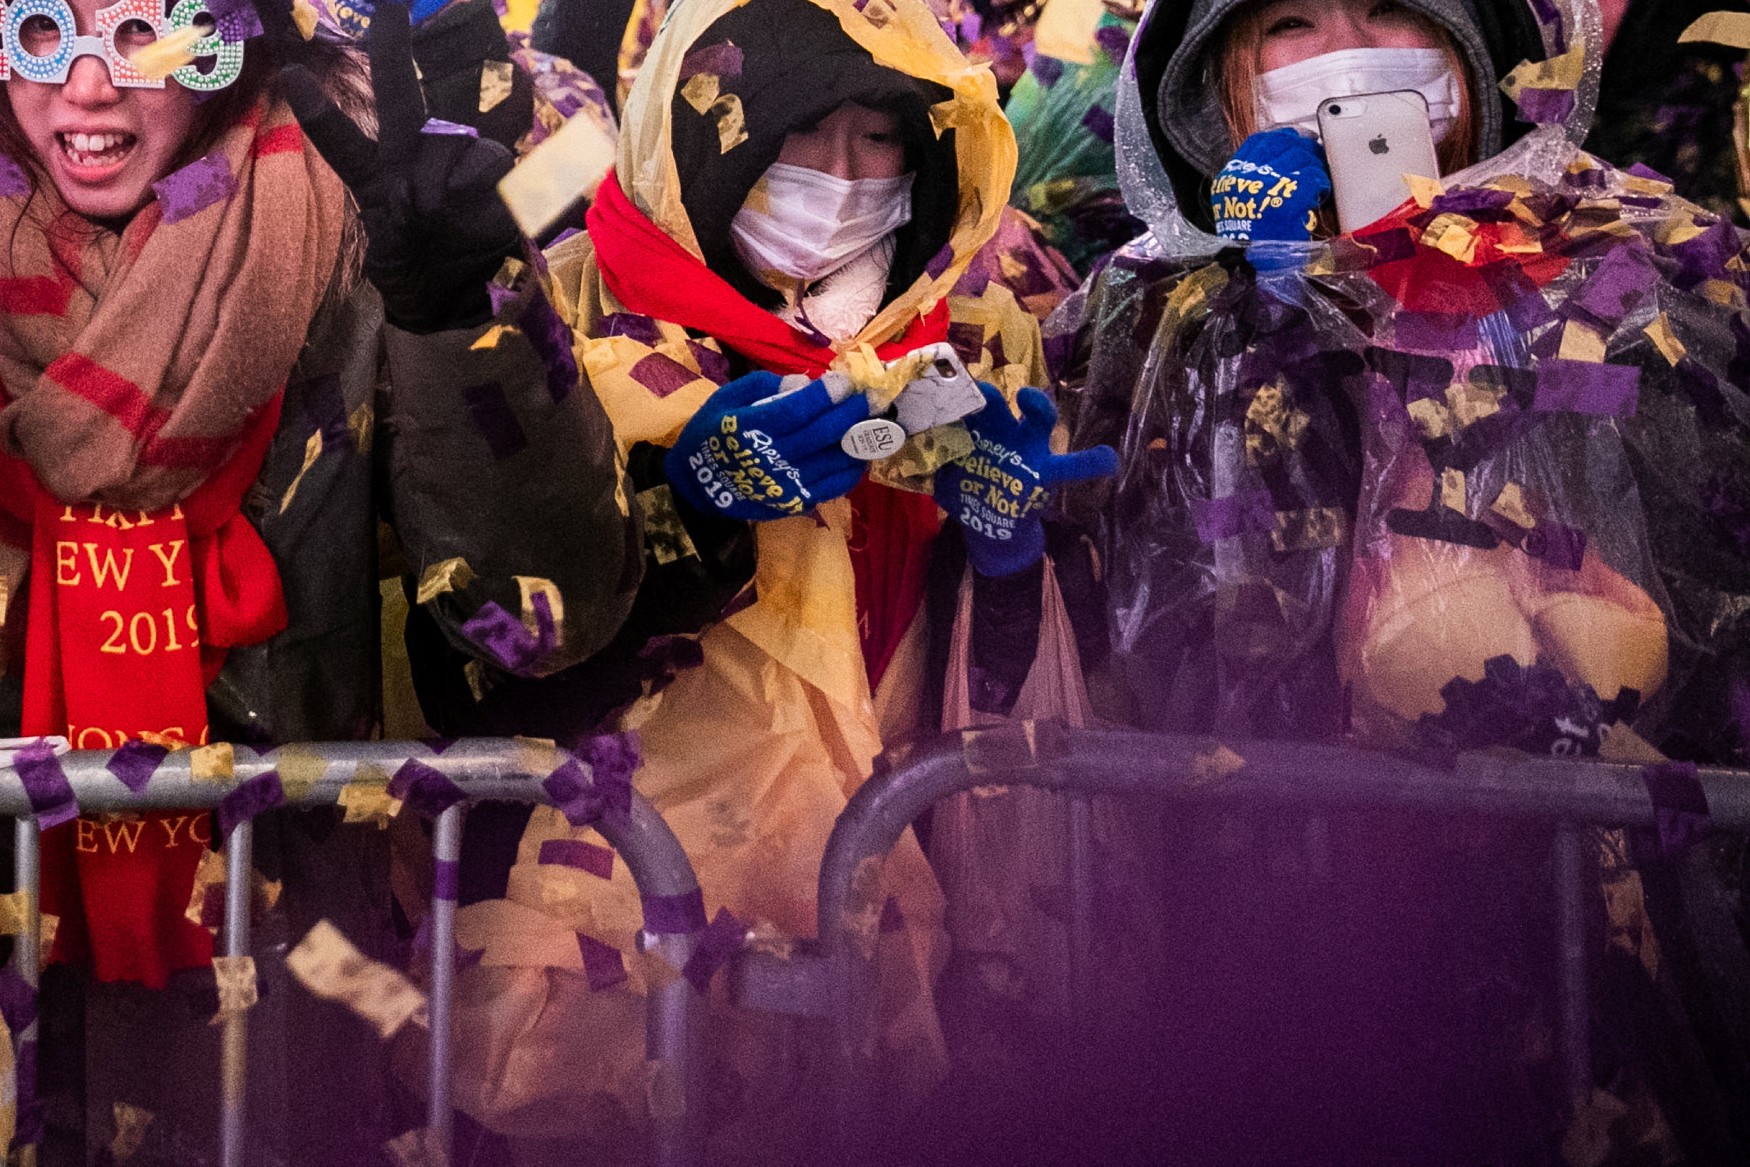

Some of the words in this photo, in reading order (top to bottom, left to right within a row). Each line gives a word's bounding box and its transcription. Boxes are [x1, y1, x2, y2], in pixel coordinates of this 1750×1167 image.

[1267, 176, 1298, 198] It
[709, 436, 729, 463] or
[721, 415, 783, 498] Believe
[688, 452, 733, 508] 2019
[959, 479, 985, 495] or
[960, 507, 1012, 540] 2019
